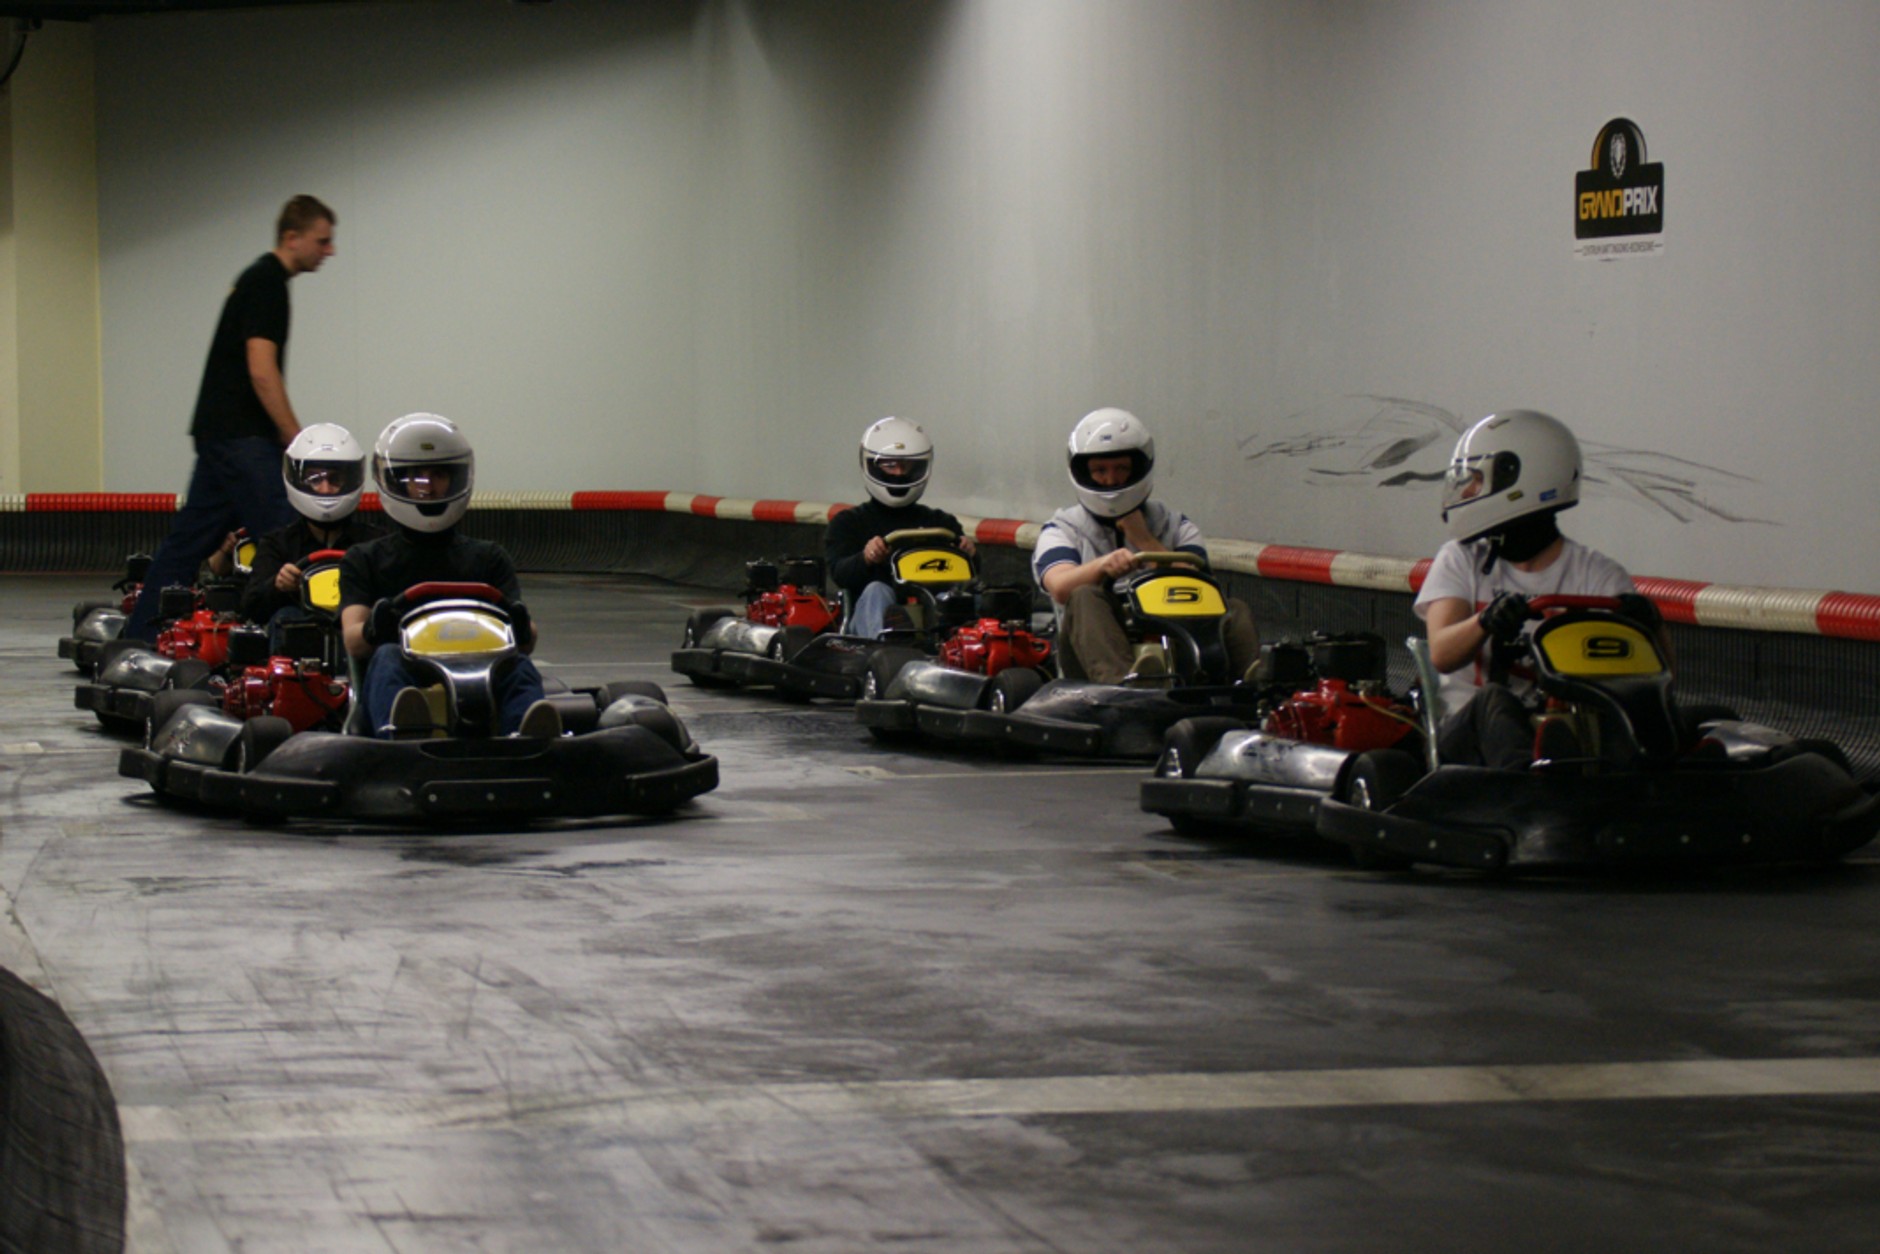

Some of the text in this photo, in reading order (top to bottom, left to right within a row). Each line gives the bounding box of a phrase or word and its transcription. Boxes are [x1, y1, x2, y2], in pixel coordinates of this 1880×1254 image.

[919, 558, 950, 572] 4
[1166, 586, 1200, 604] 5
[1586, 636, 1631, 658] 9
